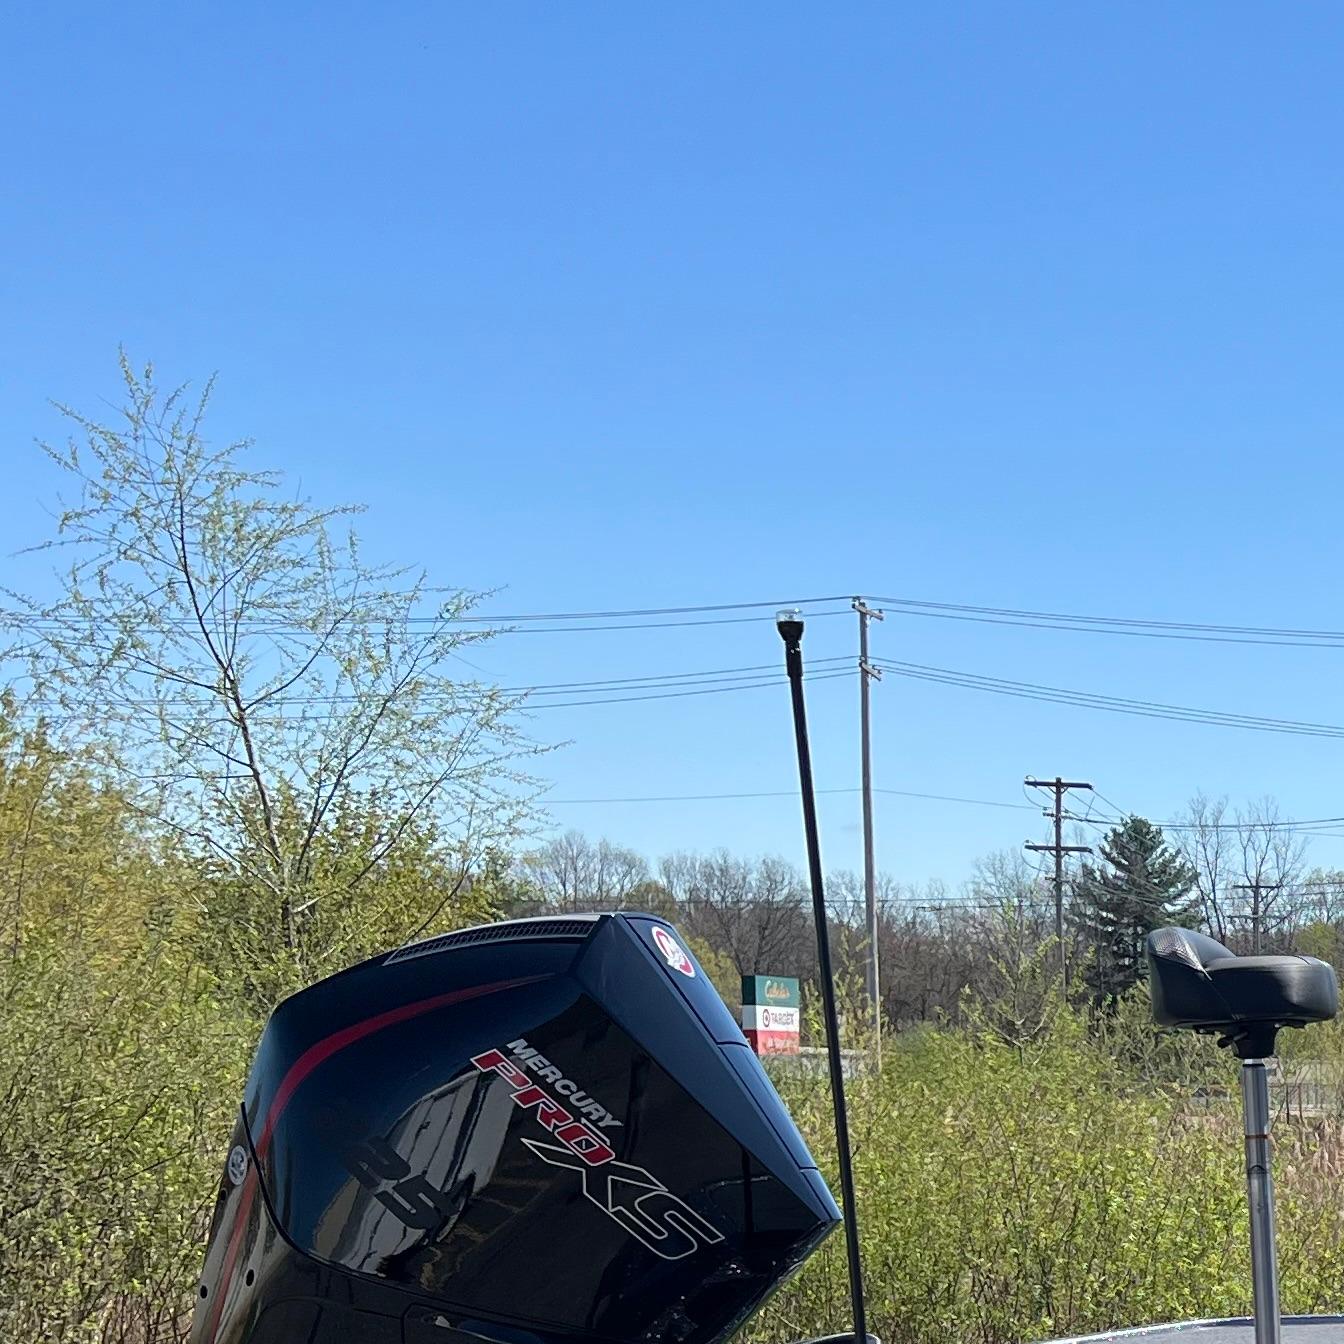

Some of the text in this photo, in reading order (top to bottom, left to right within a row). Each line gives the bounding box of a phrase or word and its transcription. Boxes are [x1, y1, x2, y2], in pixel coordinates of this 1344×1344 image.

[470, 1048, 616, 1166] PRO
[506, 1038, 624, 1128] MERCURY
[519, 1116, 726, 1261] XS
